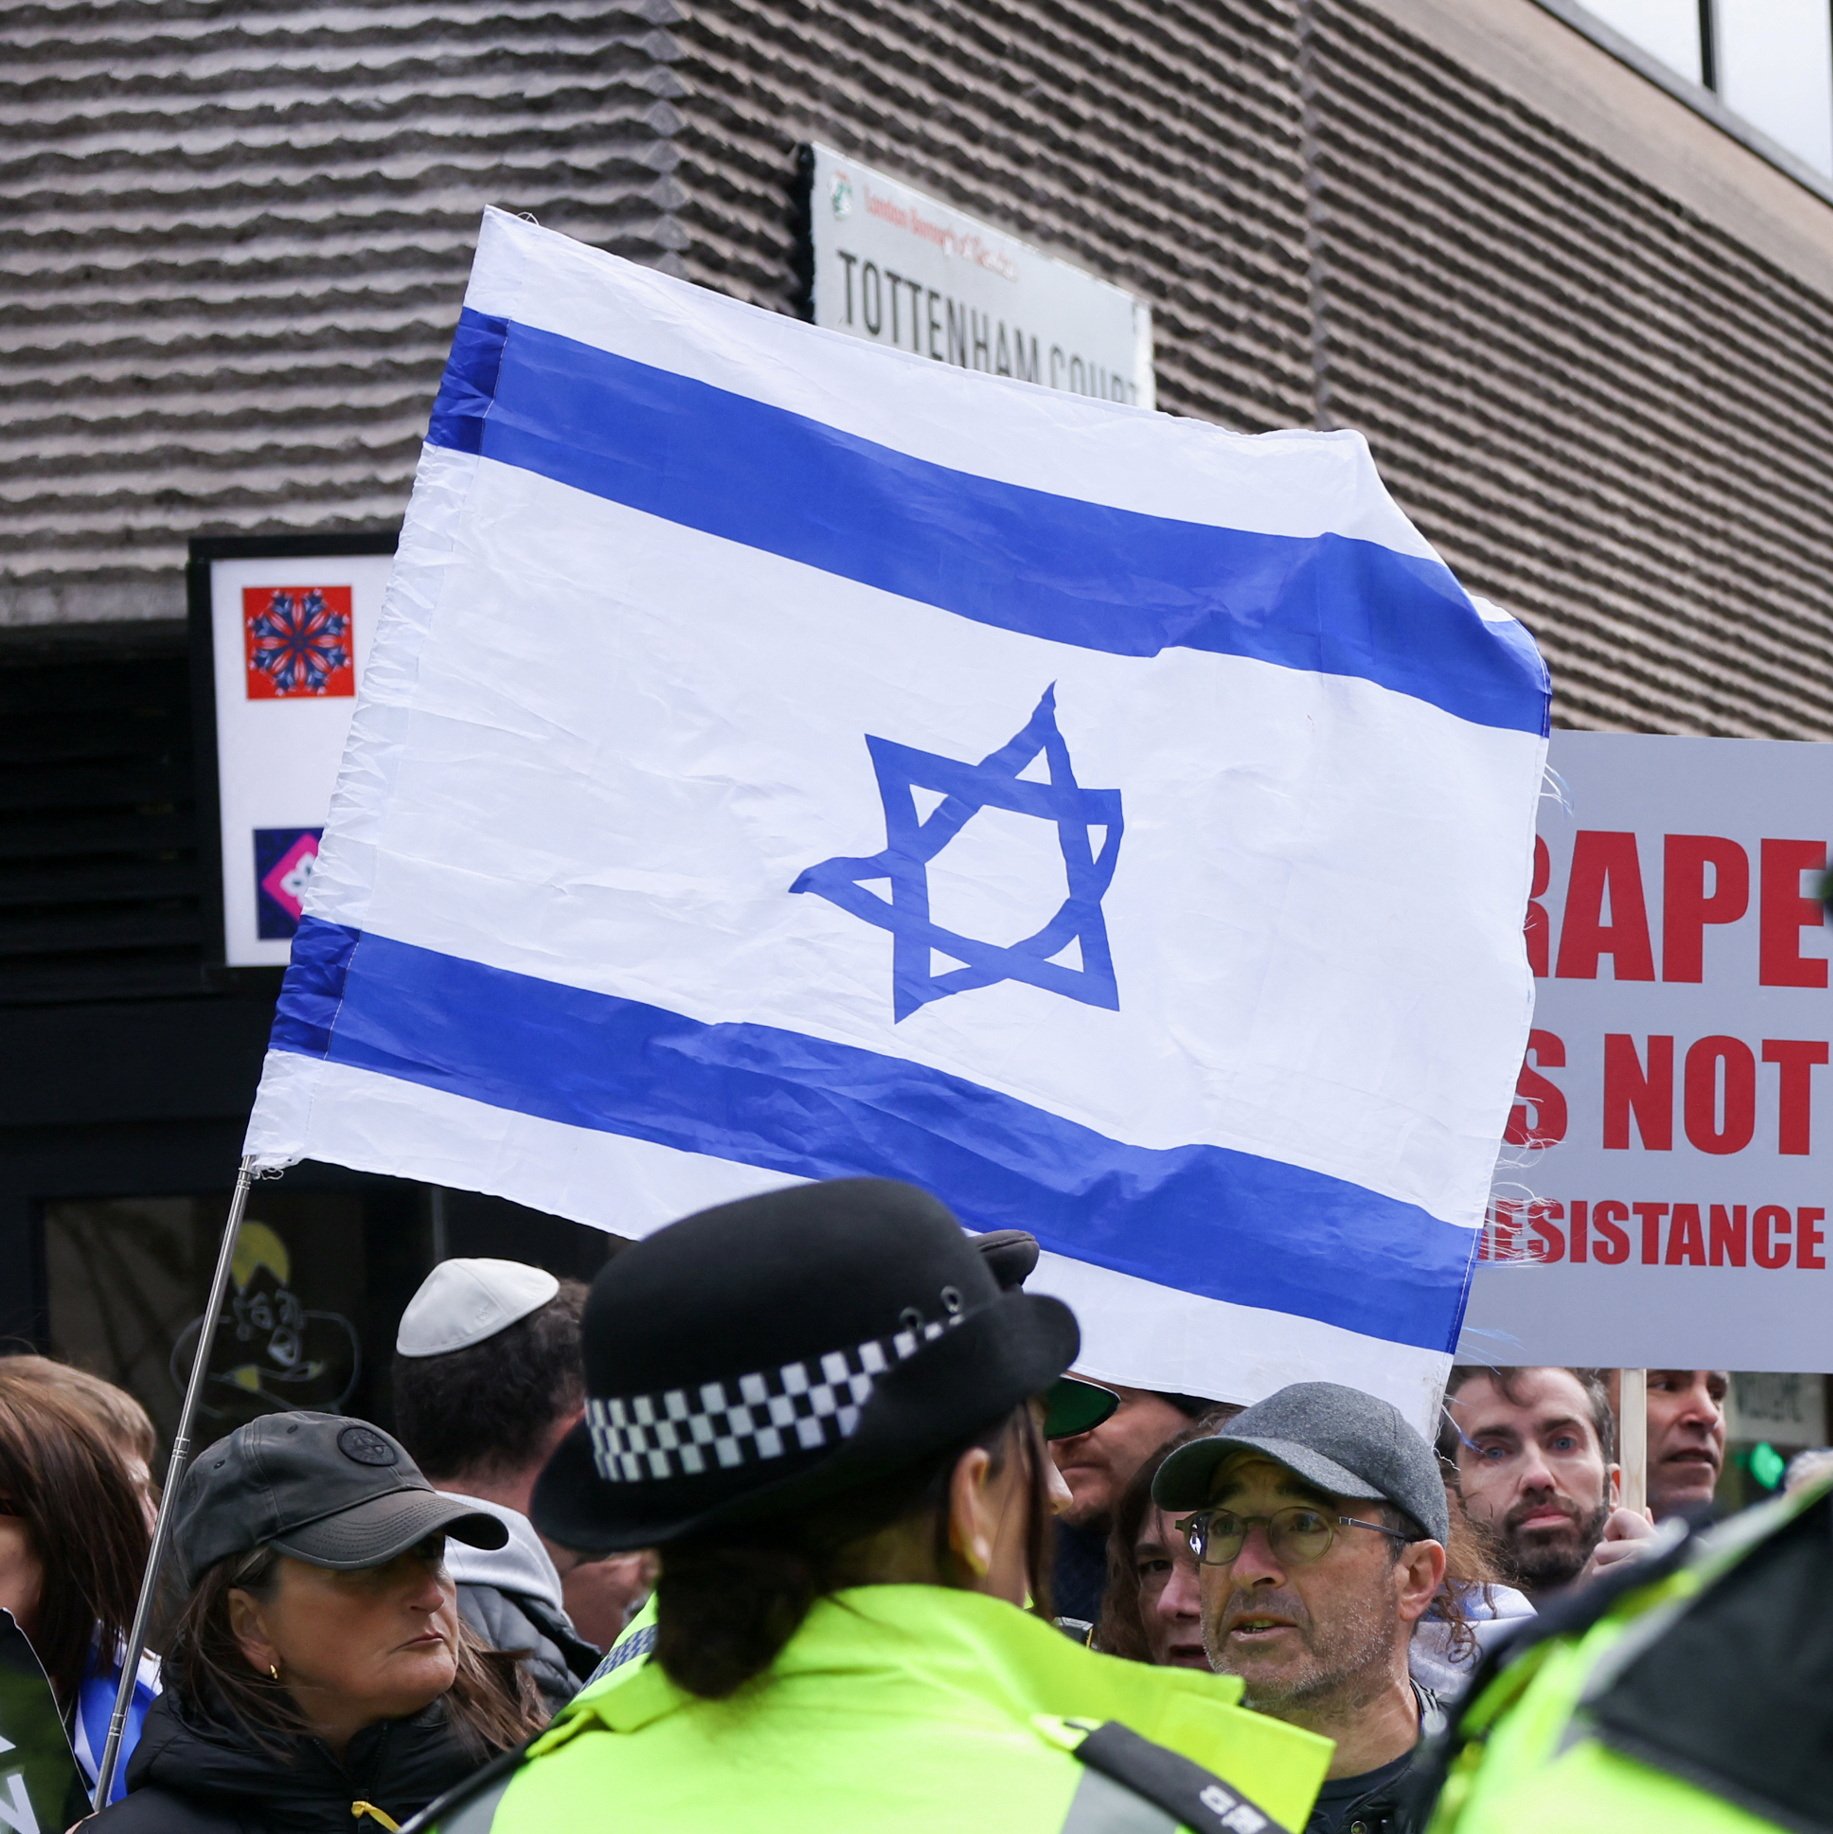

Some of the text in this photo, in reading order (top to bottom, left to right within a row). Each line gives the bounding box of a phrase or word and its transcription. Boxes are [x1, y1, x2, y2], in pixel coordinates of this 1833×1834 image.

[838, 249, 1040, 384] TOTTENHAM
[1603, 1033, 1829, 1156] NOT
[1478, 1199, 1826, 1270] ESISTANCE
